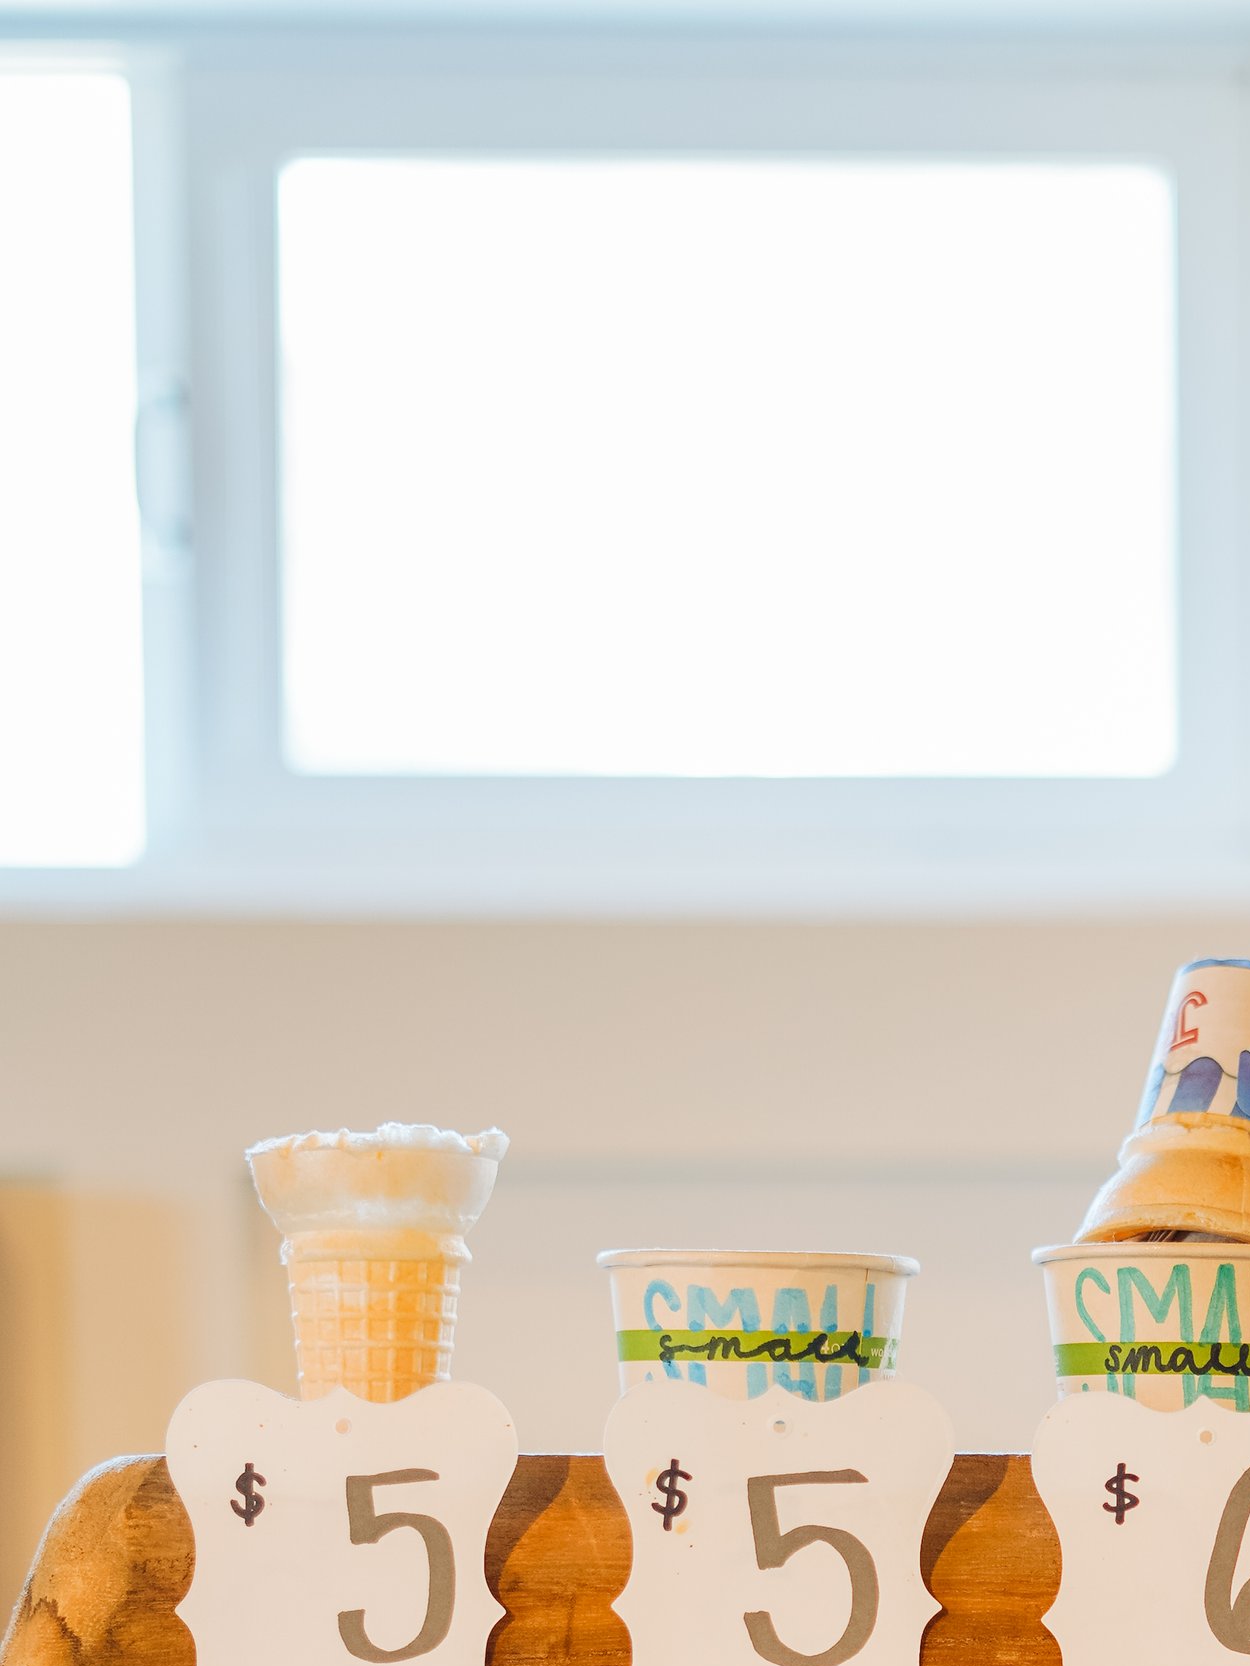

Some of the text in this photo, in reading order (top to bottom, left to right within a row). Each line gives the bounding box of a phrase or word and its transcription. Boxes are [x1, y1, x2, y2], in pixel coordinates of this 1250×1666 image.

[658, 1331, 870, 1367] small
[652, 1459, 693, 1531] $
[1103, 1463, 1140, 1525] $
[230, 1462, 457, 1664] $ 5
